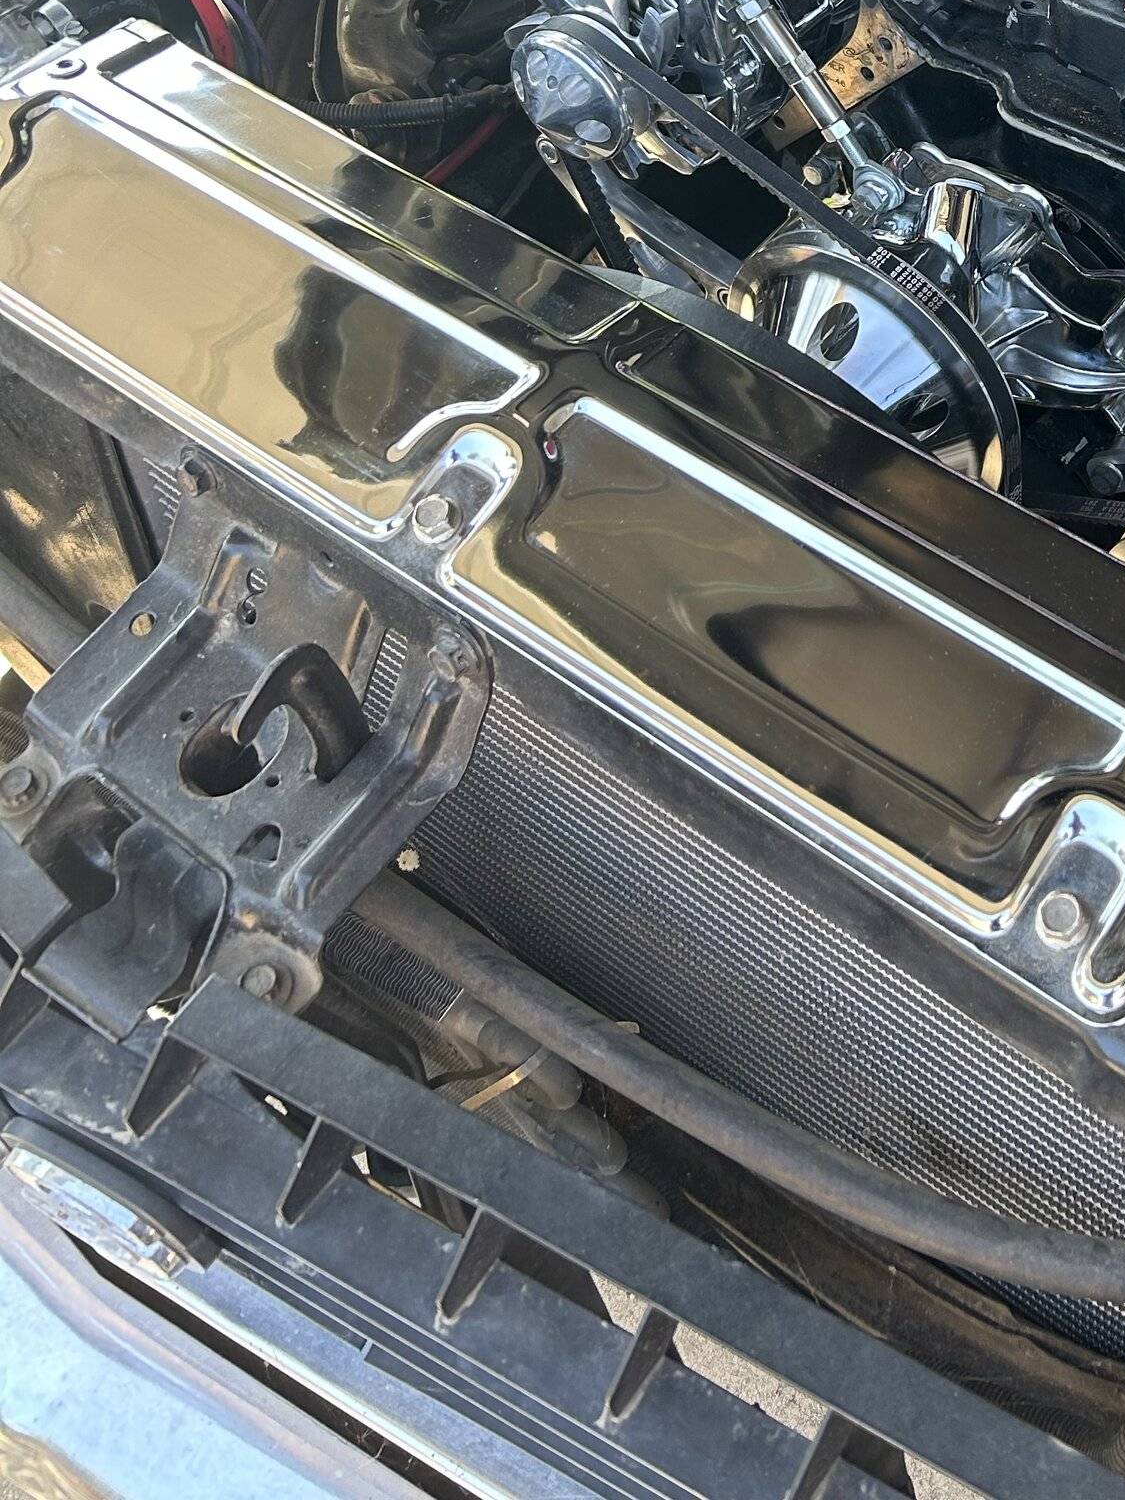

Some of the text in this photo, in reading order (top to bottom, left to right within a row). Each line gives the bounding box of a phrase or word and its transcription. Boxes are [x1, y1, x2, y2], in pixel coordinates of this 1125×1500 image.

[871, 251, 887, 264] 104
[896, 276, 917, 294] 2012
[901, 270, 923, 288] 2012
